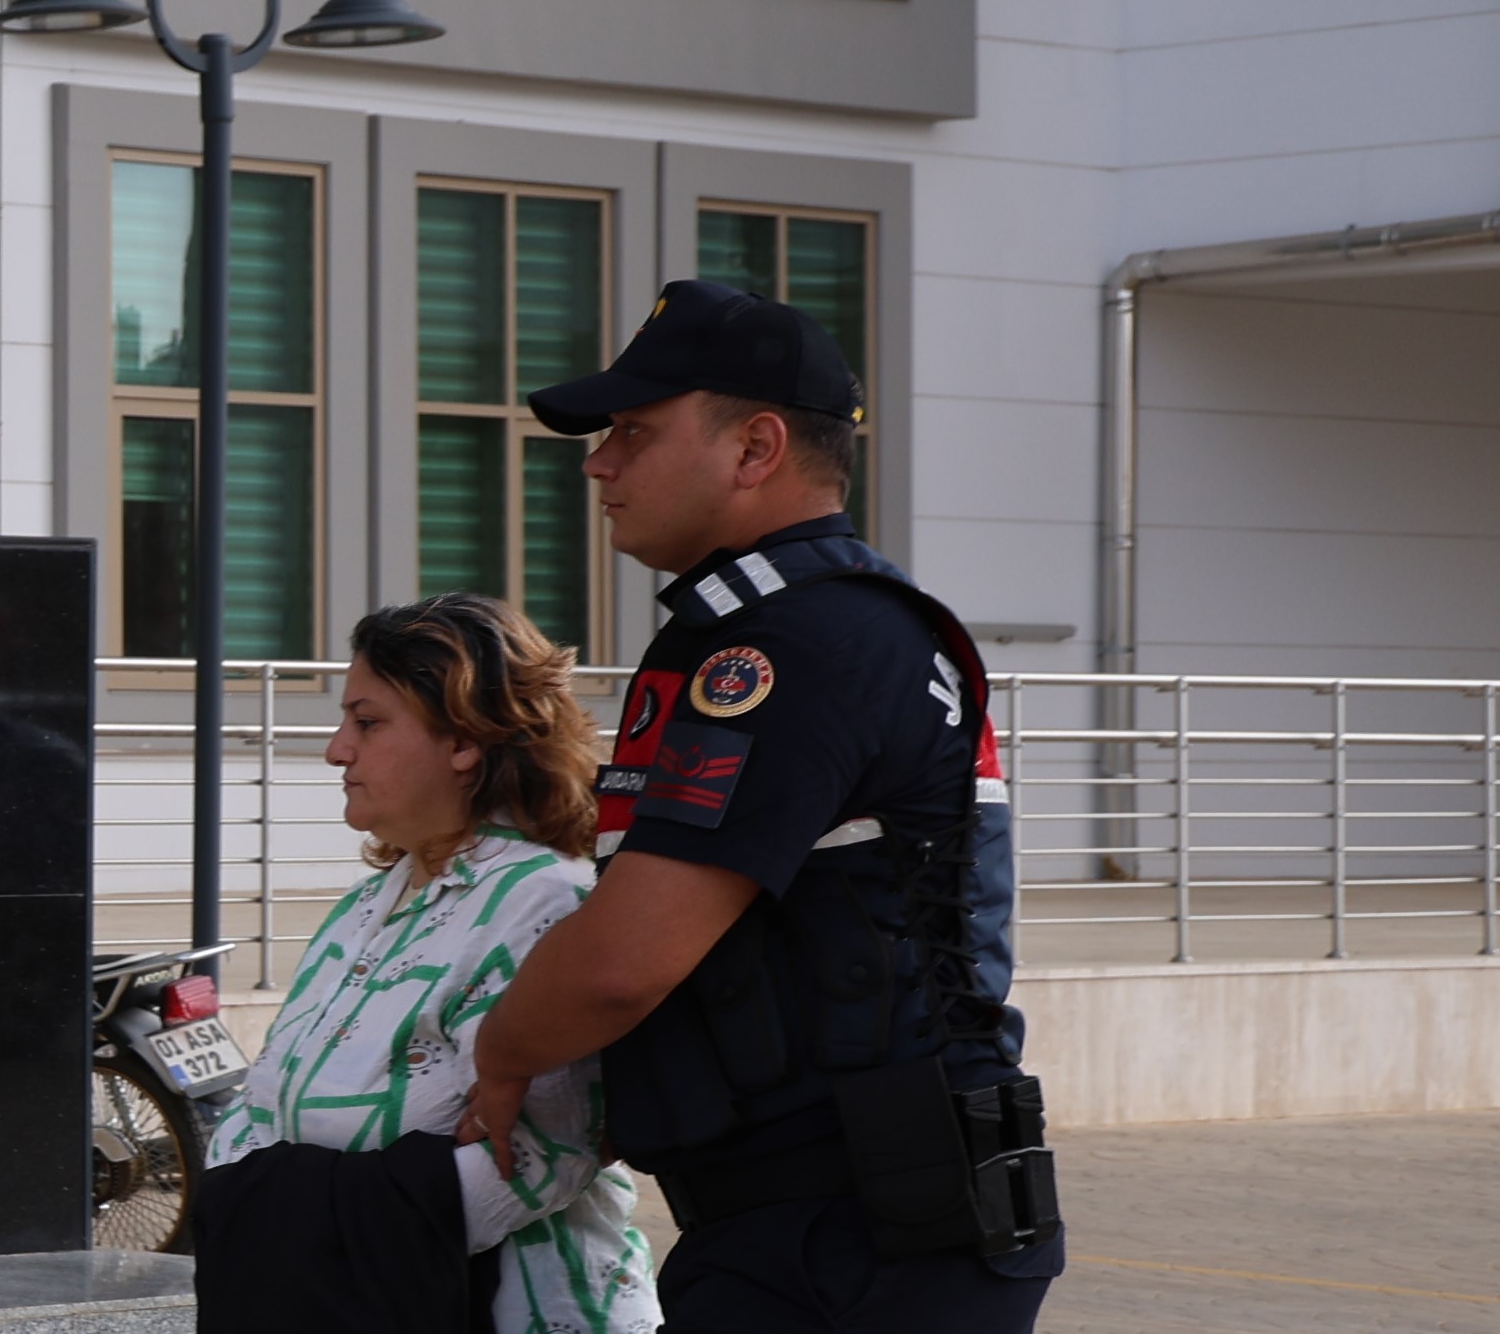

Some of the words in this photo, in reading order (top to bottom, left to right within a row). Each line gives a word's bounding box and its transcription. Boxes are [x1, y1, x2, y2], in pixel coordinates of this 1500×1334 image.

[155, 1034, 184, 1059] 01
[184, 1022, 228, 1051] ASA
[185, 1051, 229, 1078] 372
